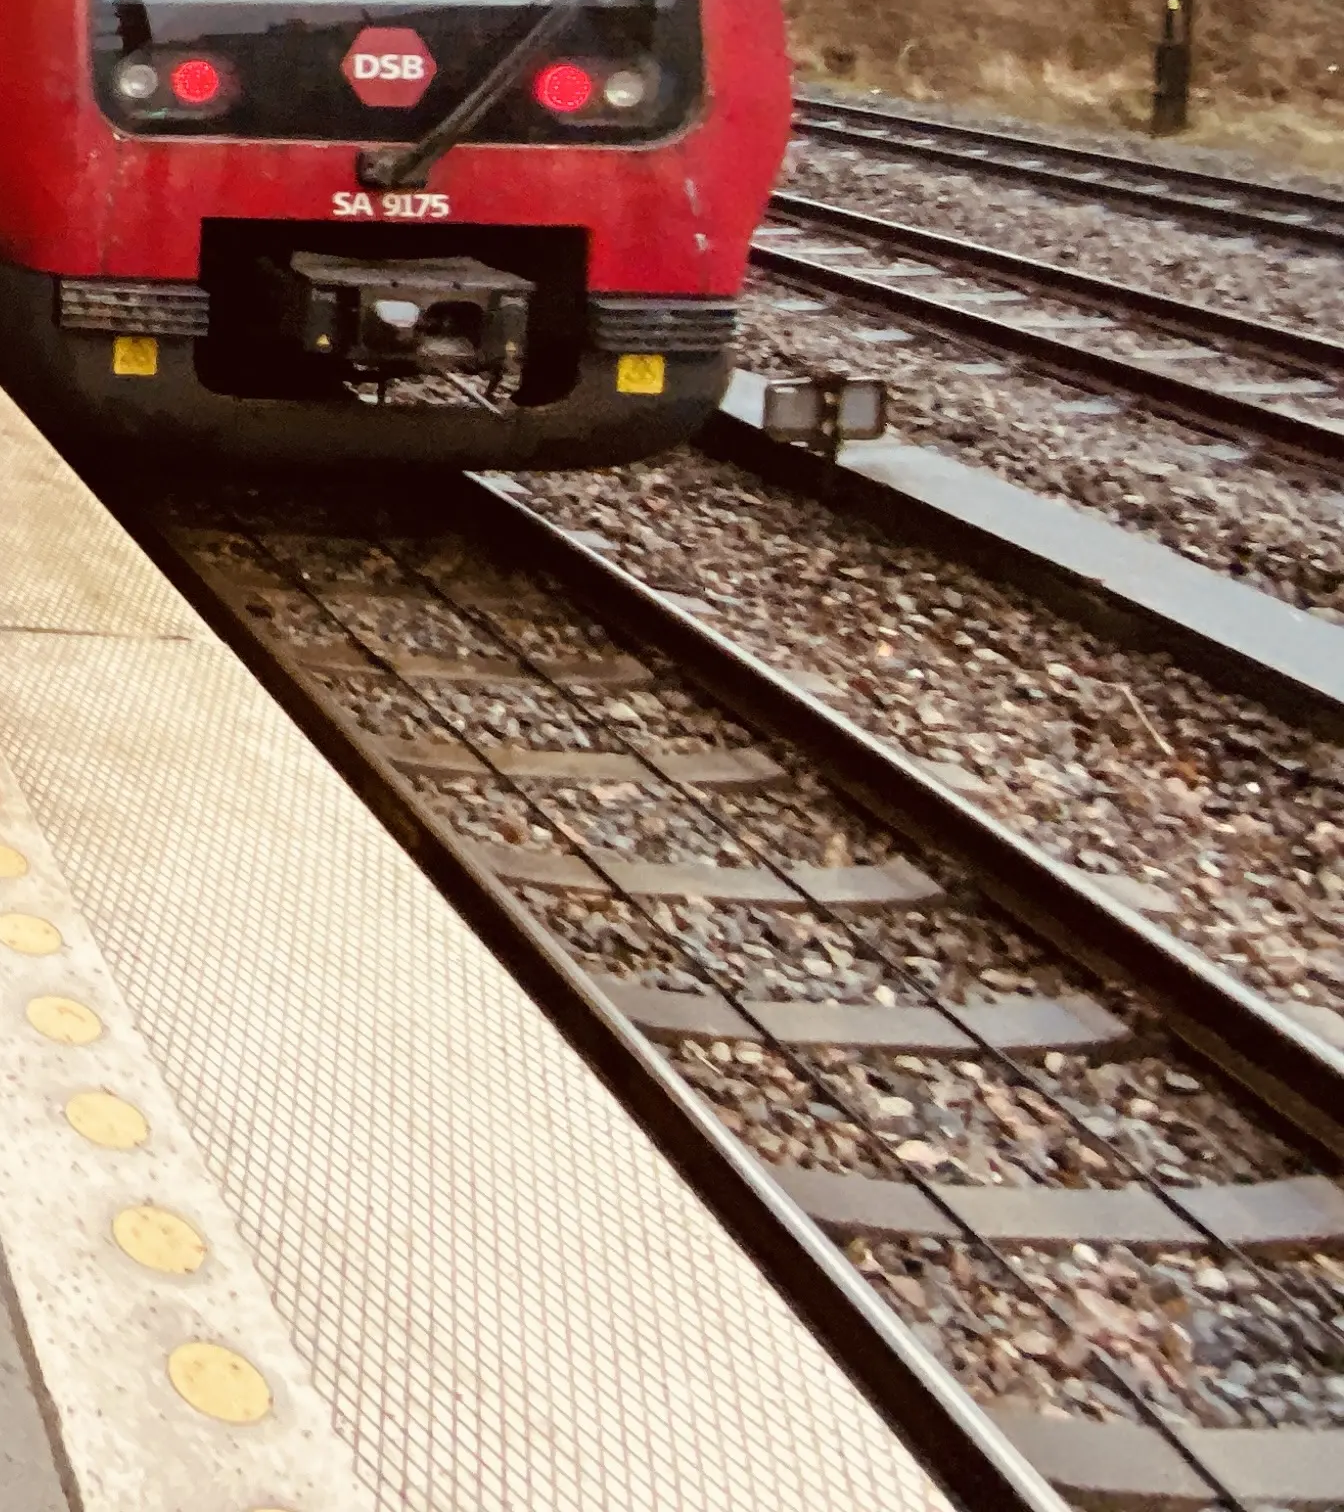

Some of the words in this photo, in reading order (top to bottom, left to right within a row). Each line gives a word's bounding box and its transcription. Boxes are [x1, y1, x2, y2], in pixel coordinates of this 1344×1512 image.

[352, 55, 425, 80] DSB
[332, 192, 374, 216] SA
[382, 192, 450, 218] 9175
